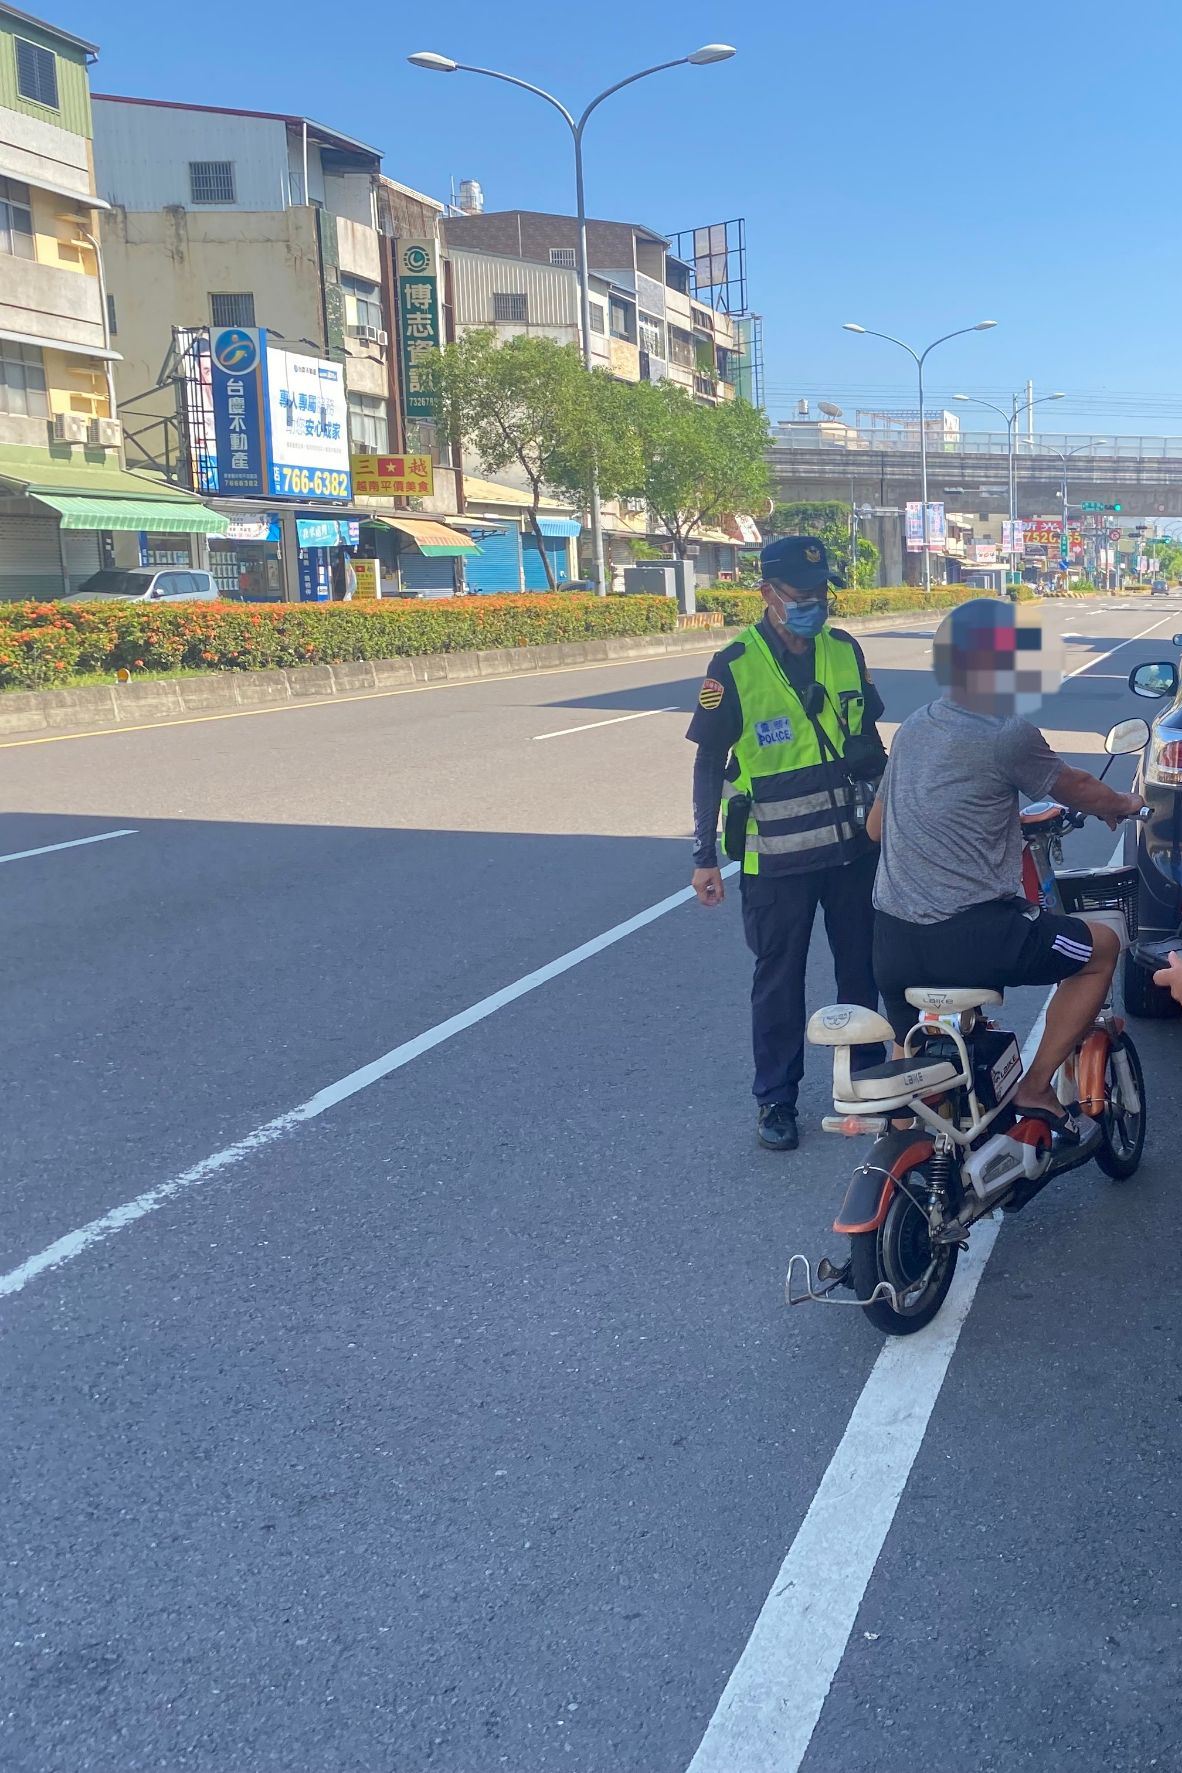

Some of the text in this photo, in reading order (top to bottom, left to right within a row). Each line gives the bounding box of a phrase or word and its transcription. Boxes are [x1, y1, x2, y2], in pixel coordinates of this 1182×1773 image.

[409, 397, 437, 407] 732678
[227, 378, 249, 469] 台慶不動產
[283, 467, 348, 496] 766-6382
[759, 729, 790, 745] POLICE
